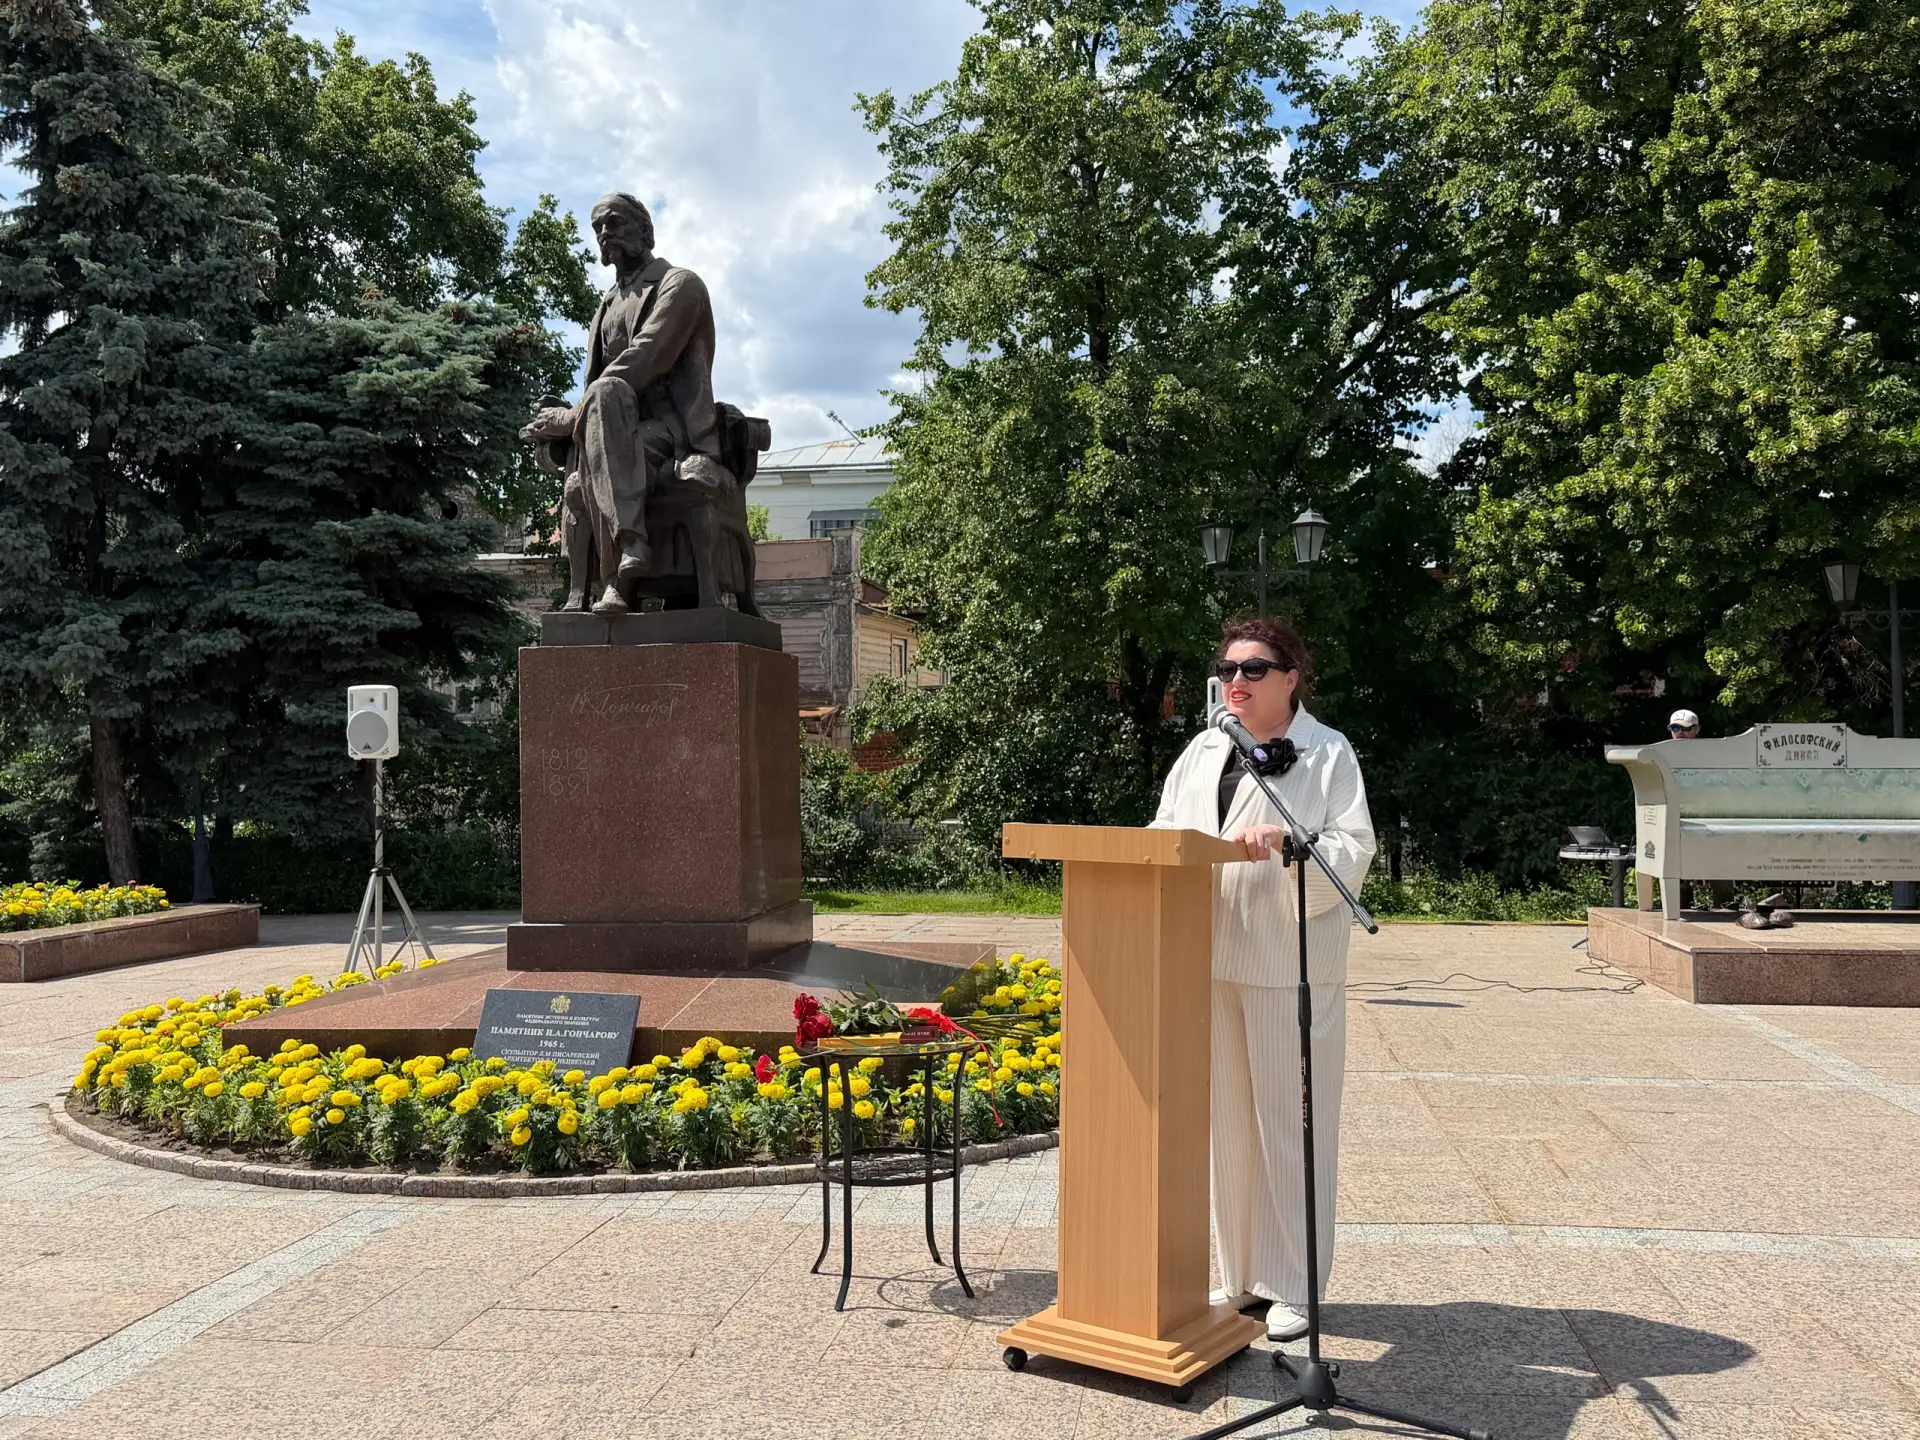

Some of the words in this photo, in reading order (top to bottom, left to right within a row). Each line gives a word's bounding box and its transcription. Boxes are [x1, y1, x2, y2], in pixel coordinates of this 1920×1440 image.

[1763, 733, 1841, 753] ФИЛОСОФСКИЙ
[542, 748, 588, 770] 1812
[1784, 750, 1819, 761] ДИВАН
[542, 774, 589, 796] 1891
[491, 1026, 544, 1036] ПАМЯТНИК
[539, 1040, 557, 1048] 1965
